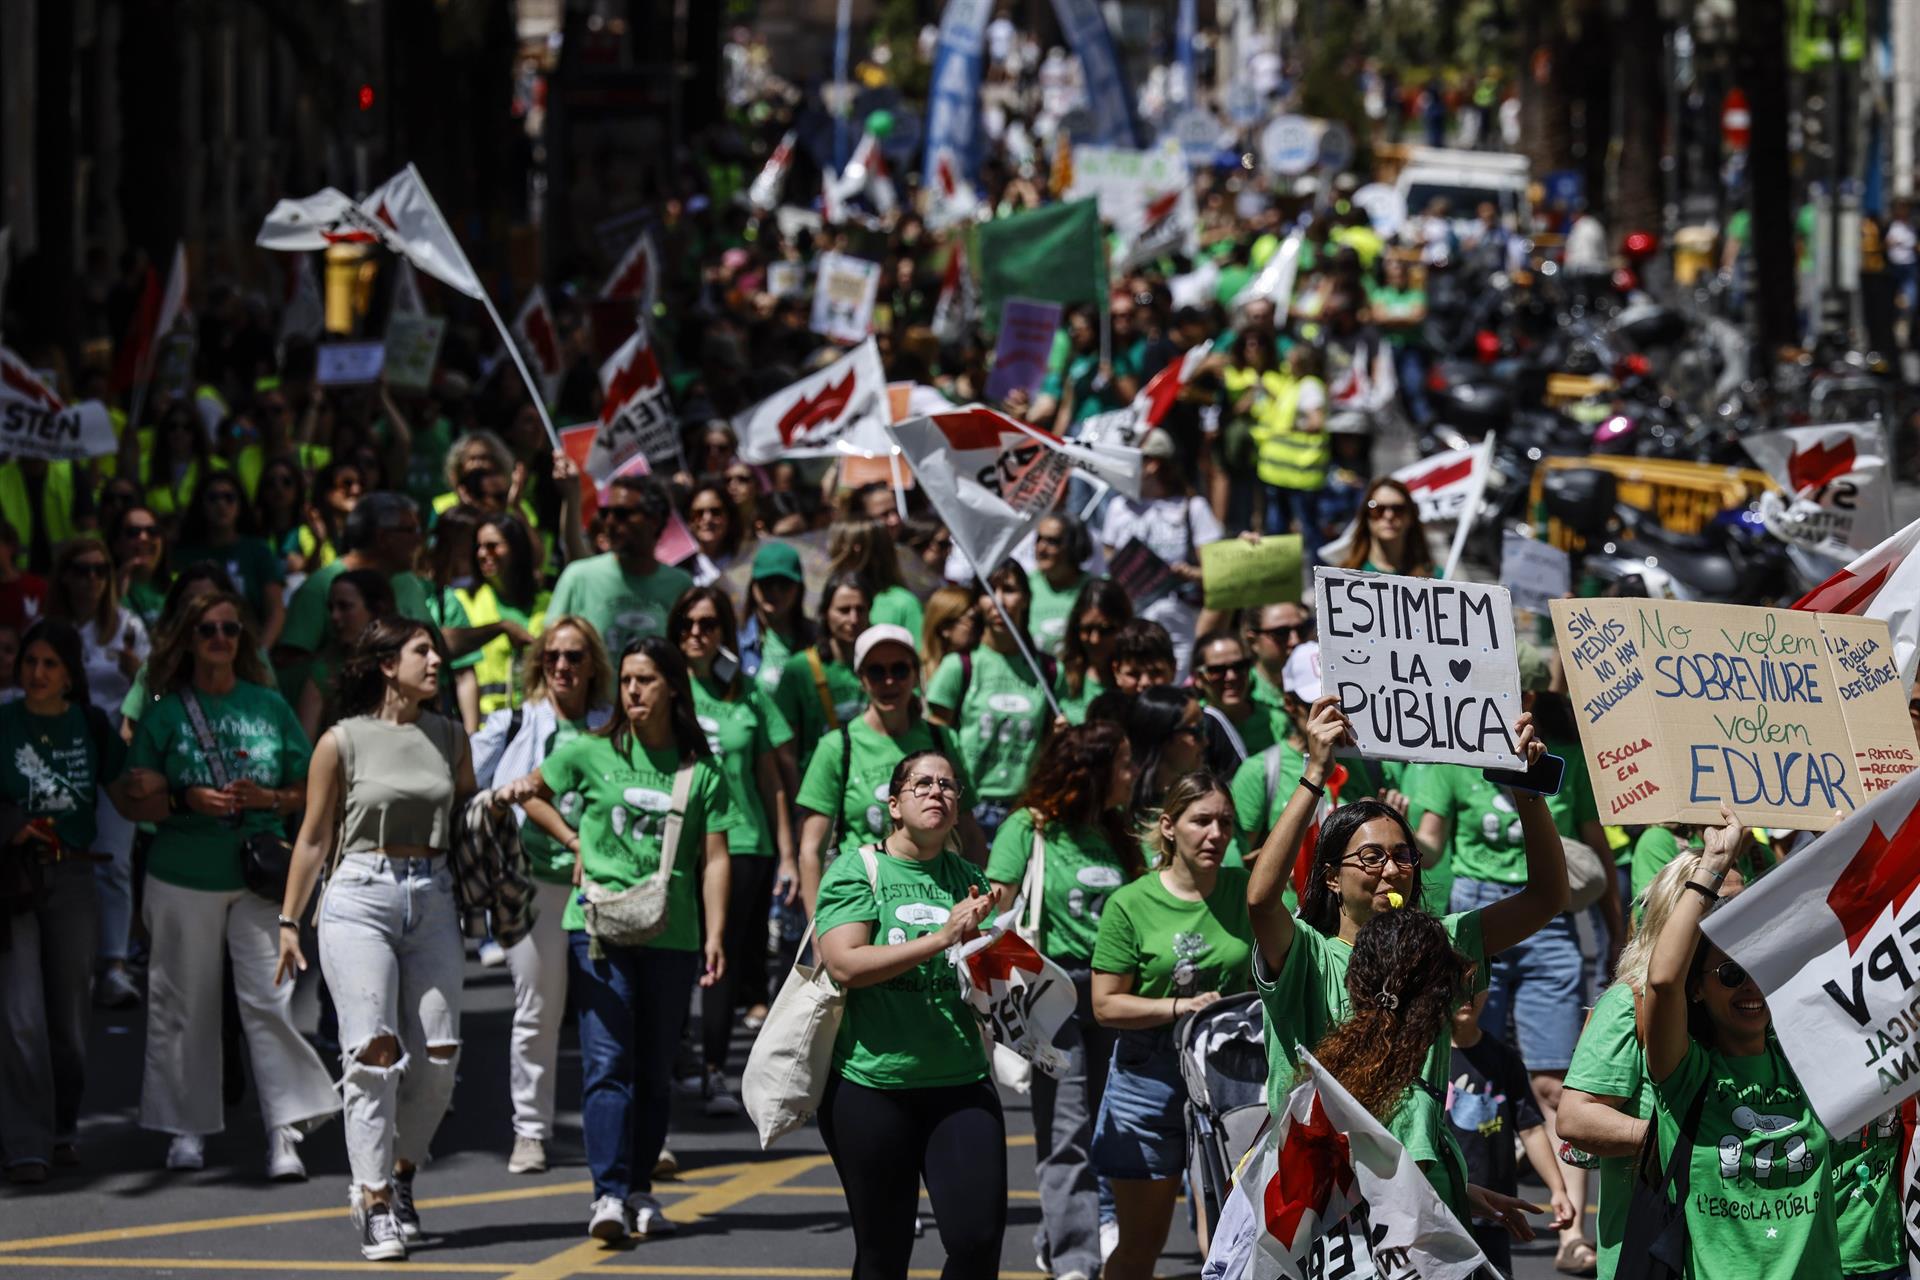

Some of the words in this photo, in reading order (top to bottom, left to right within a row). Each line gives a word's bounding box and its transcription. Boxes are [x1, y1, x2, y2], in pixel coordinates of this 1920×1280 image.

[3, 402, 82, 441] STEN
[1325, 577, 1499, 649] ESTIMEM
[1568, 607, 1596, 640] SIN
[1638, 609, 1692, 650] No
[1720, 613, 1819, 657] volem
[1571, 618, 1626, 671] MEDIOS
[1593, 659, 1617, 683] NO
[1614, 639, 1639, 667] HAY
[1390, 651, 1432, 686] LA
[1655, 652, 1823, 703] SOBREVIURE
[1856, 661, 1872, 677] SE
[1583, 667, 1645, 724] INCLUSIÓN
[1338, 682, 1516, 755] PÚBLICA
[1713, 704, 1812, 746] volem
[1597, 738, 1653, 770] ESCOLA
[1617, 762, 1639, 781] EN
[1610, 780, 1660, 815] LLUITA
[1689, 745, 1856, 810] EDUCAR
[1697, 1193, 1771, 1220] L'ESCOLA
